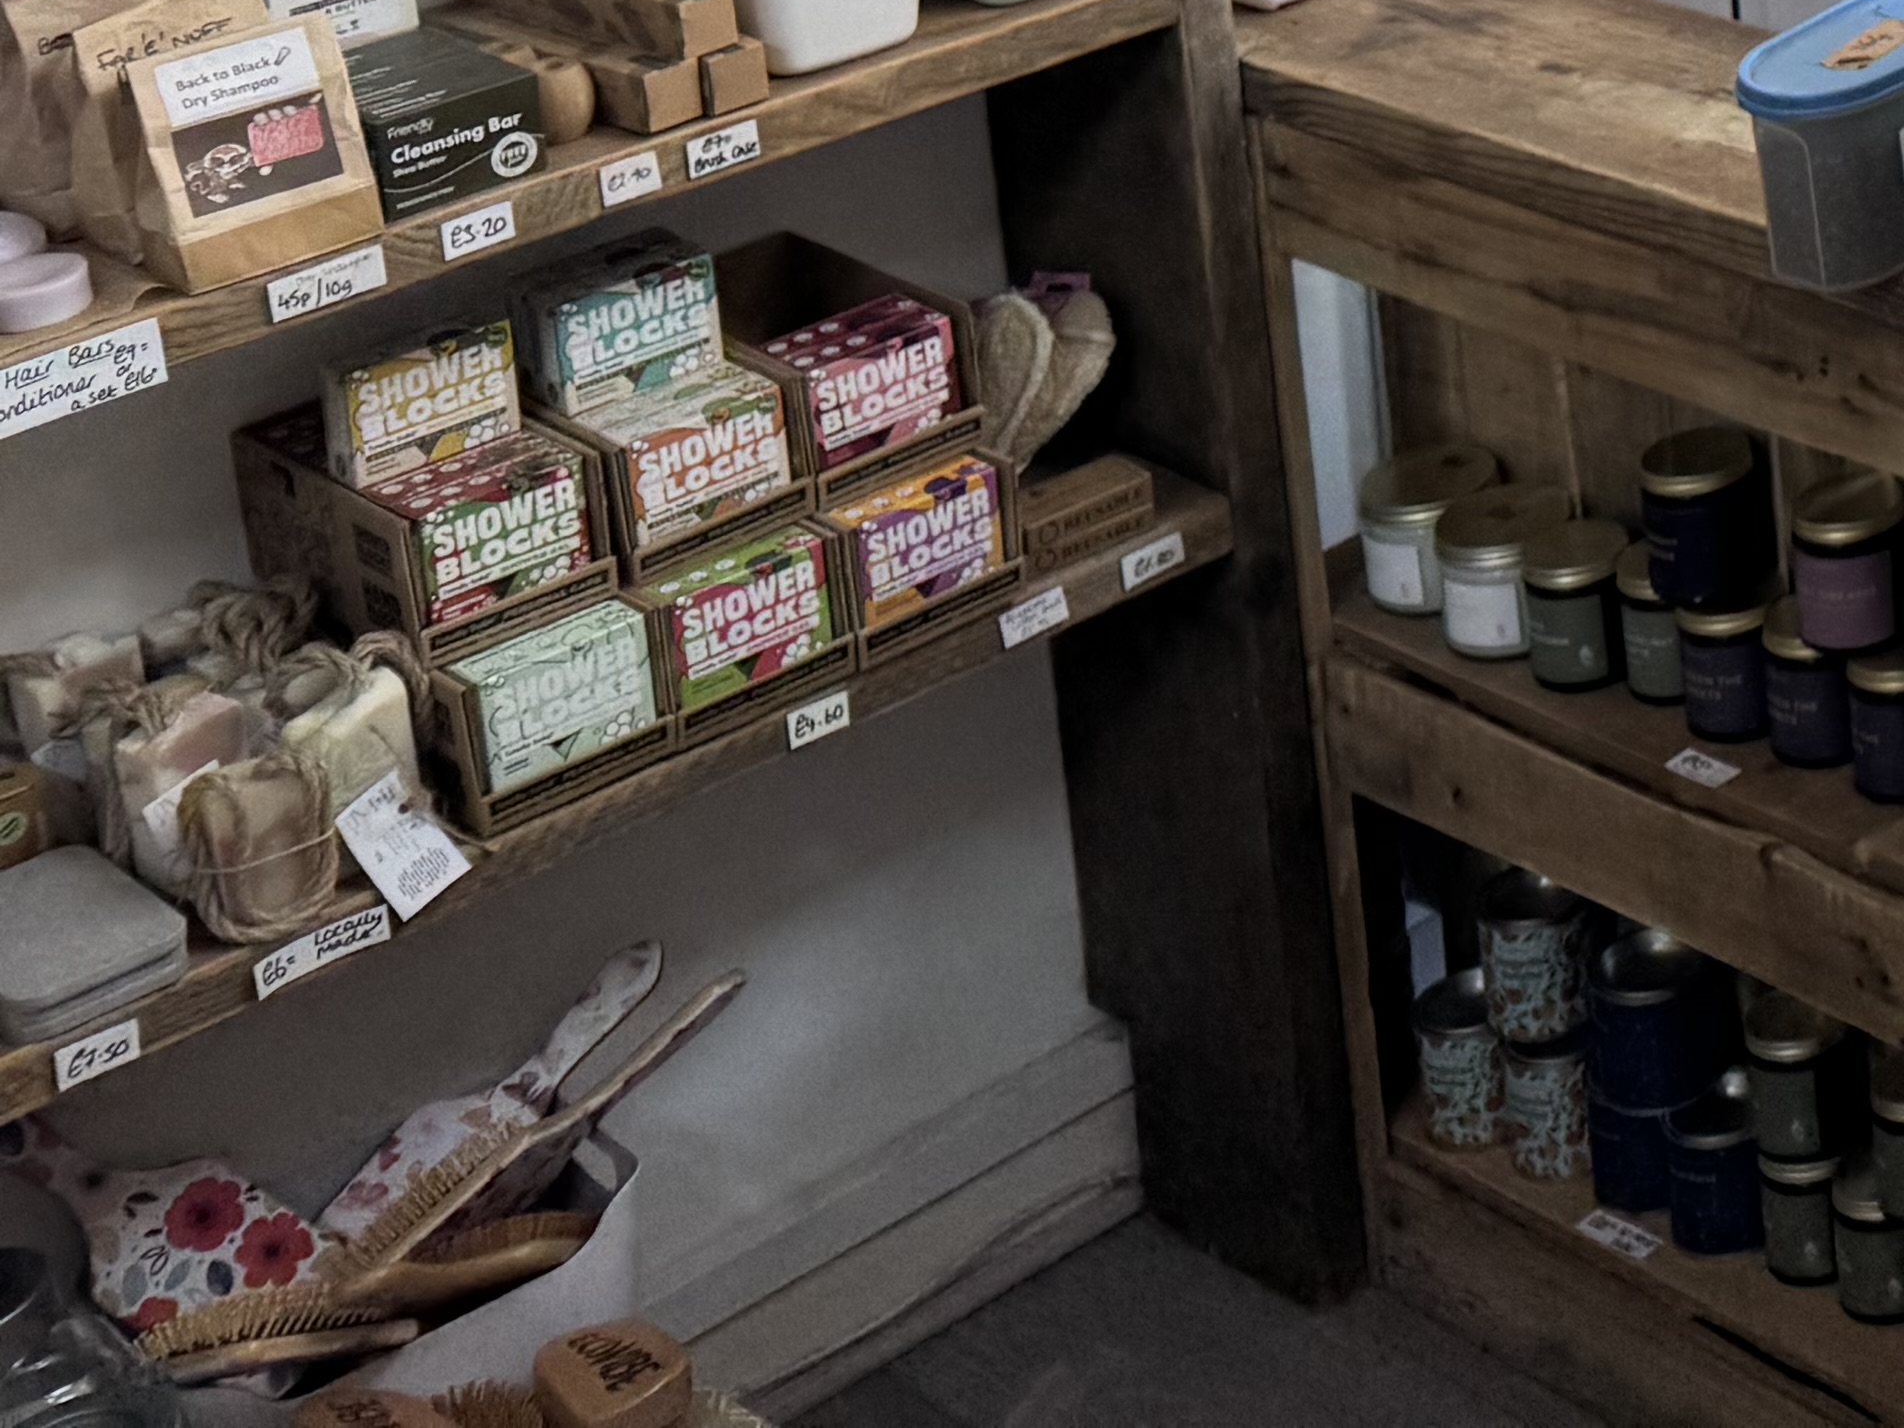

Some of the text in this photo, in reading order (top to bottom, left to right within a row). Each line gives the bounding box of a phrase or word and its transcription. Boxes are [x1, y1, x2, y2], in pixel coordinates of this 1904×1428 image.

[175, 57, 273, 93] Back to Black
[181, 75, 279, 111] Dry Shampoo
[390, 112, 523, 165] Cleansing Bar
[566, 274, 705, 337] SHOWER
[567, 300, 708, 374] BLOCKS
[0, 373, 97, 423] onditioner
[4, 359, 54, 390] Hair
[68, 339, 115, 367] Bars
[357, 344, 501, 406] SHOWER
[819, 334, 944, 412] SHOWER
[358, 369, 508, 441] BLOCKS
[820, 364, 949, 441] BLOCKS
[637, 409, 778, 478] SHOWER
[637, 434, 780, 509] BLOCKS
[432, 477, 574, 556] SHOWER
[434, 507, 581, 584] BLOCKS
[867, 487, 991, 563] SHOWER
[869, 515, 994, 590] BLOCKS
[680, 560, 817, 640] SHOWER
[683, 591, 820, 669] BLOCKS
